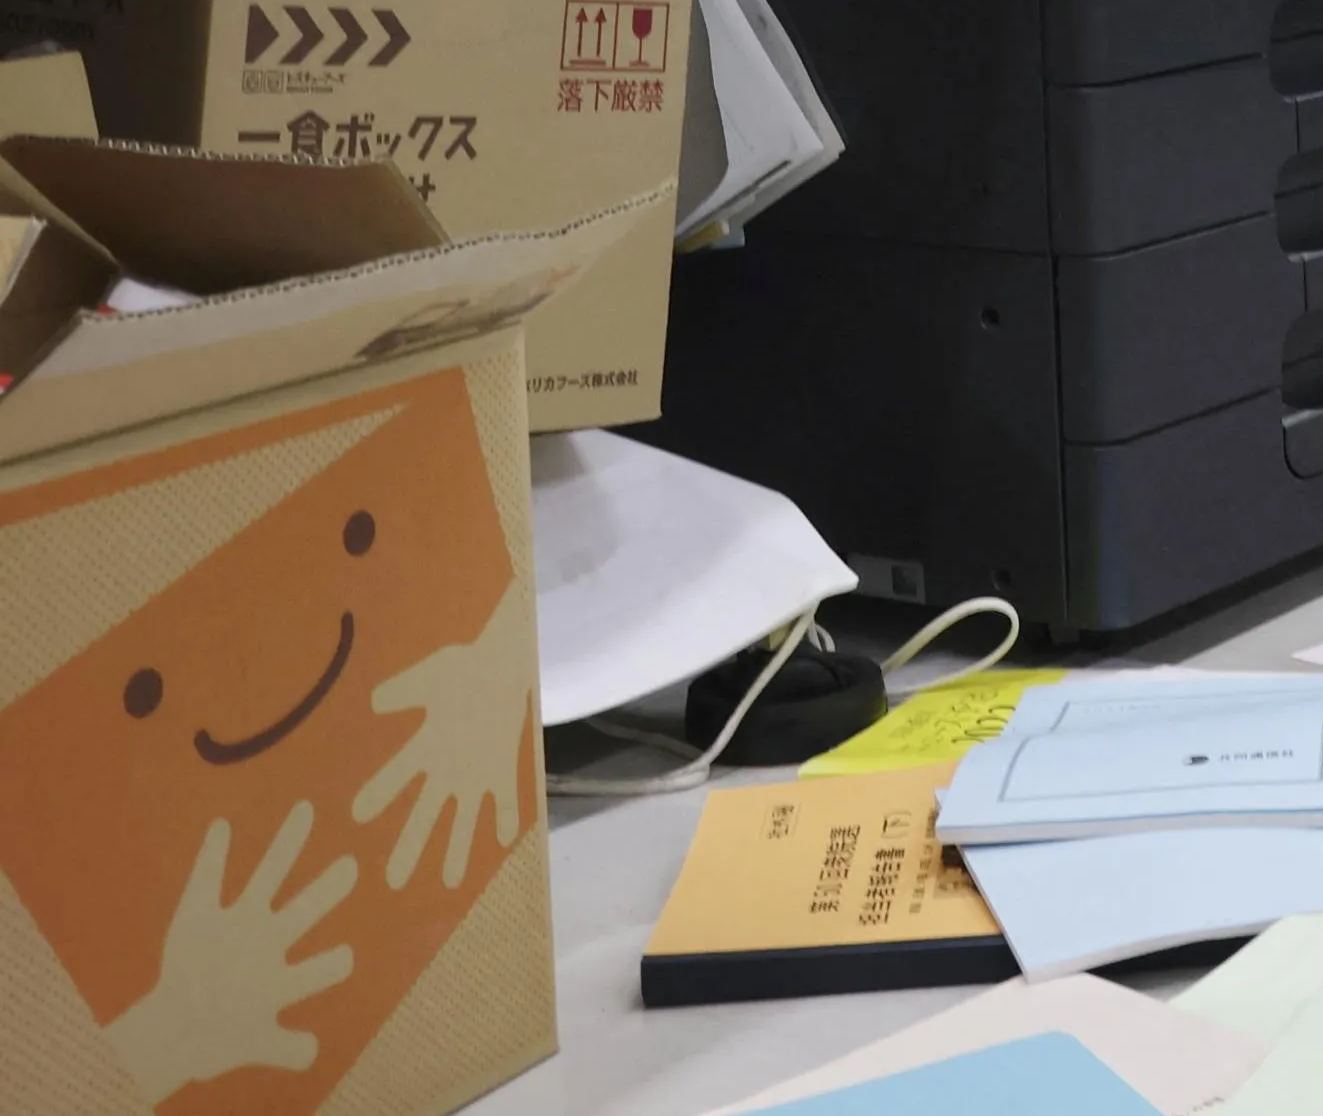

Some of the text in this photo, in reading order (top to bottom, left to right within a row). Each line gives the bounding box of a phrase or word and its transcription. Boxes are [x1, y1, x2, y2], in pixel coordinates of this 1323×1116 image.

[557, 78, 665, 113] 落下厳禁
[237, 109, 478, 162] 一食ボックス
